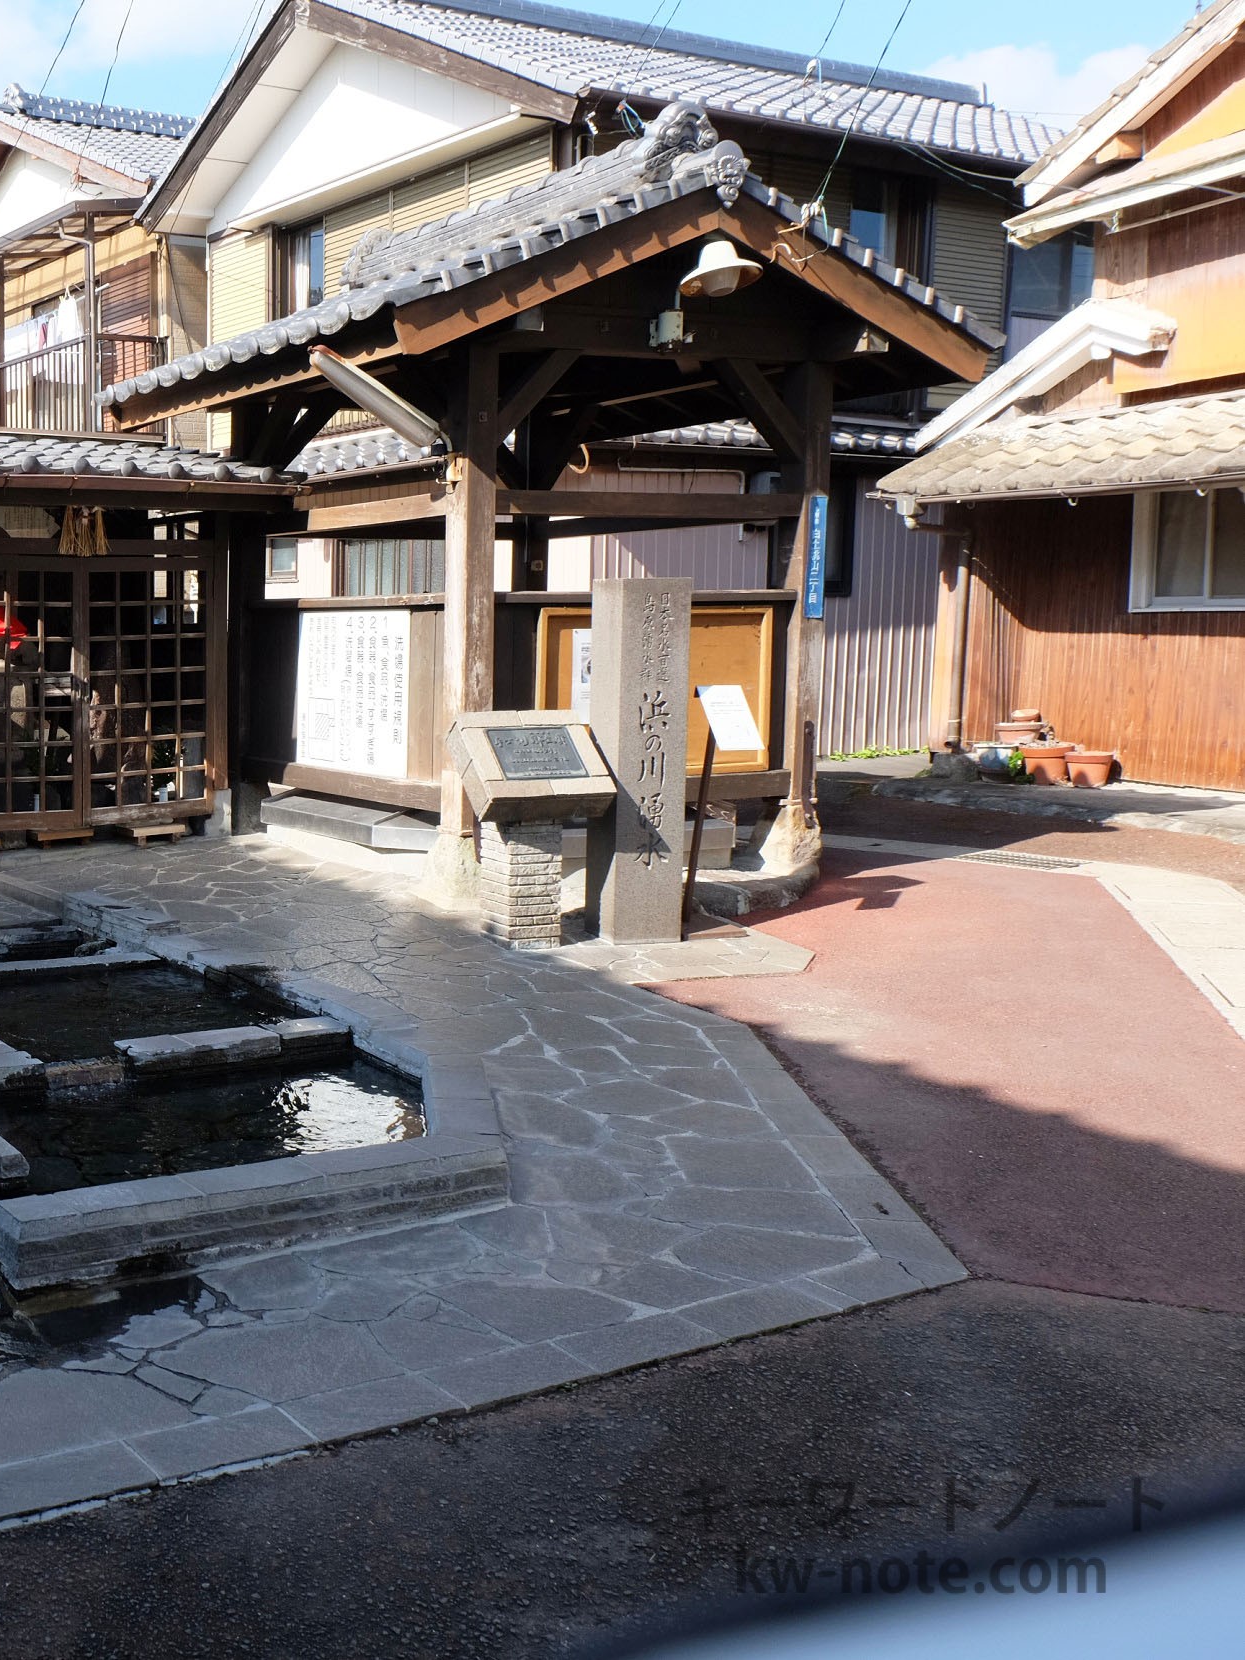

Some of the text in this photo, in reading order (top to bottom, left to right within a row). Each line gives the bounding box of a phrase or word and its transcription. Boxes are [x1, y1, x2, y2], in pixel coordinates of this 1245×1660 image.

[639, 592, 656, 682] 島原湧水群
[656, 591, 676, 684] 日本名水百選
[633, 690, 672, 872] 浜の川湧水
